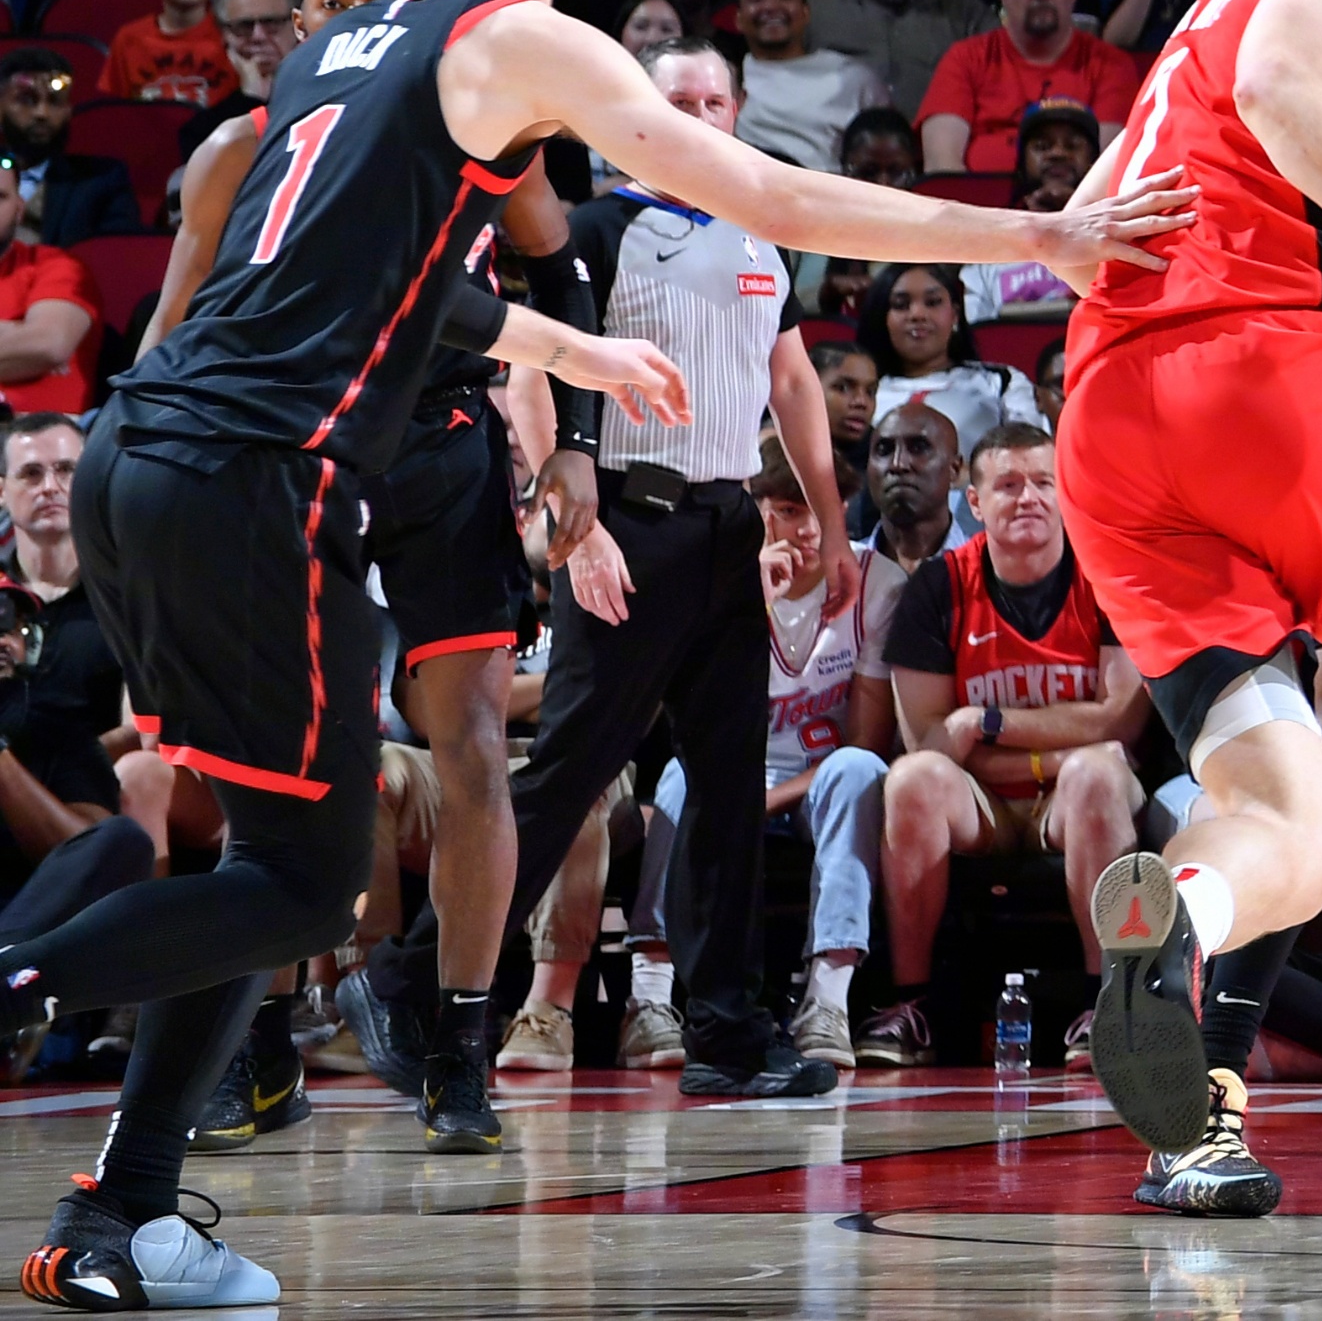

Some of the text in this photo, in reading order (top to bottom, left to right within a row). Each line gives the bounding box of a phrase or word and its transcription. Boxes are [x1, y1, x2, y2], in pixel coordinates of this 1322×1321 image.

[315, 24, 410, 76] DICK
[249, 104, 347, 264] 1
[817, 660, 854, 676] karma
[818, 649, 852, 666] credit
